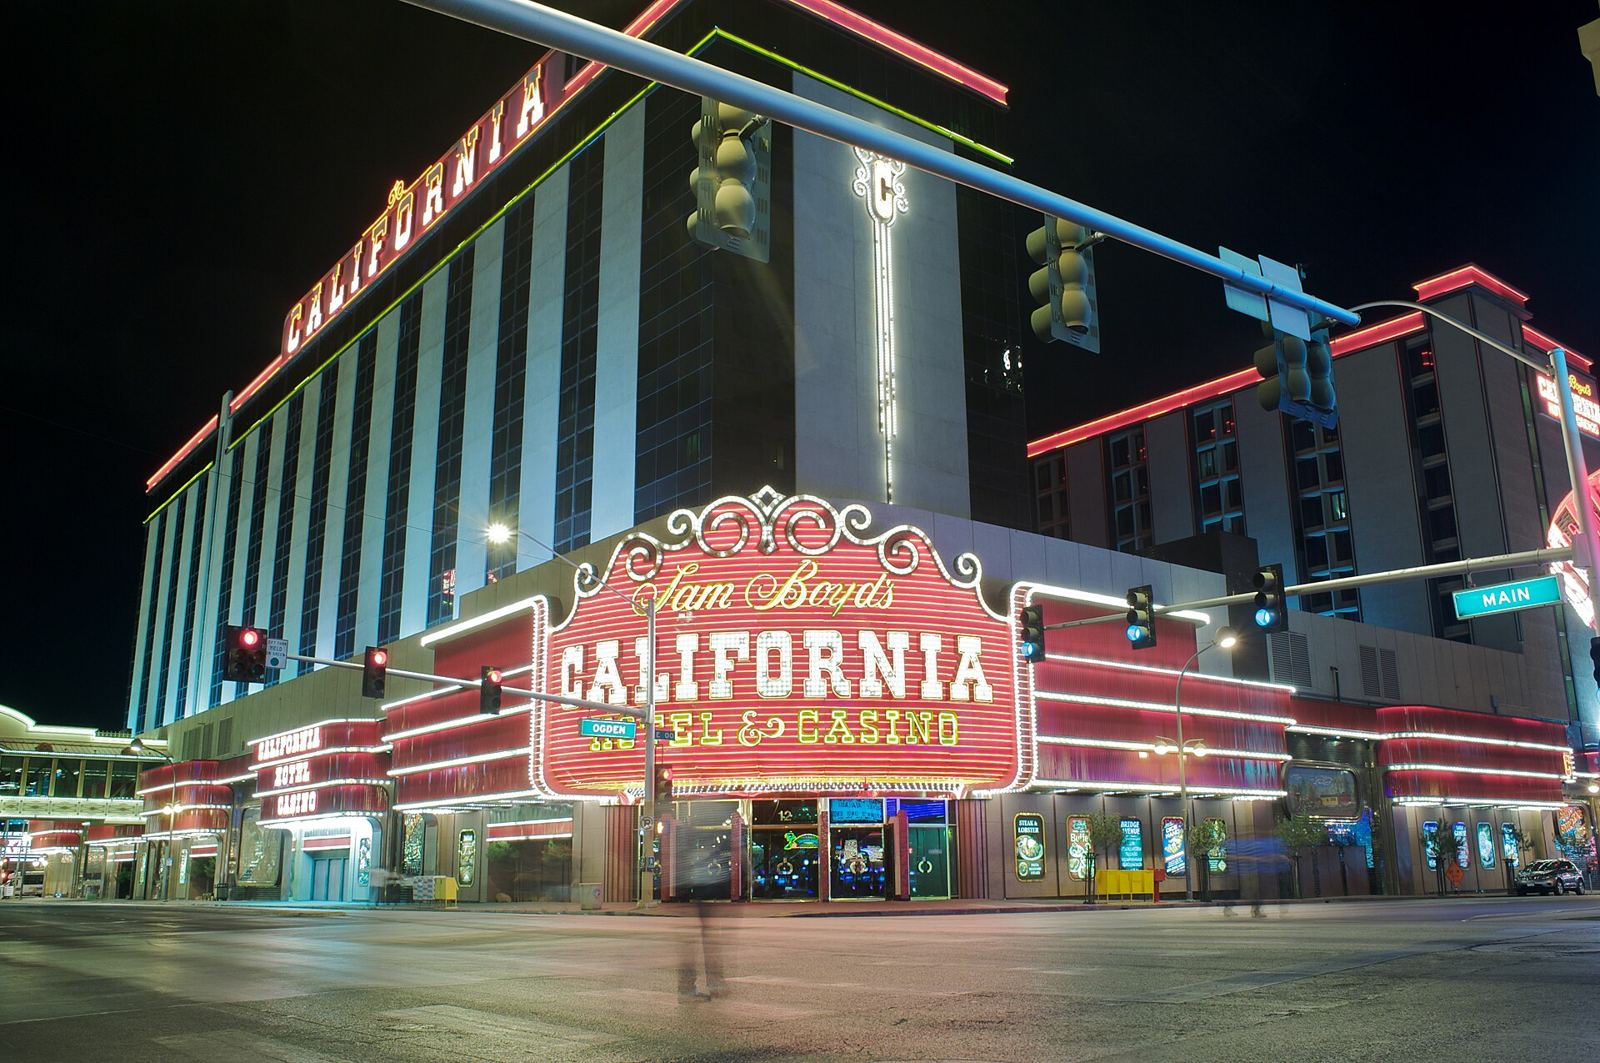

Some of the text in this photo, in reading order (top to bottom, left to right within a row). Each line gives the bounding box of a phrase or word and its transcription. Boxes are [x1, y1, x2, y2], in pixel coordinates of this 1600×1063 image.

[287, 63, 544, 354] CALIFORNIA
[632, 559, 895, 618] Sam Boyd's
[1482, 586, 1531, 608] MAIN
[560, 629, 994, 710] CALIFORNIA
[592, 723, 626, 735] OGDEN
[738, 709, 785, 747] &
[798, 708, 960, 747] CASINO
[257, 727, 320, 761] CALIFORNIA
[274, 761, 310, 787] HOTEL
[277, 791, 316, 816] CASINO
[778, 810, 793, 821] 12
[1120, 820, 1140, 828] BRIDGE
[1070, 832, 1091, 842] Buffe
